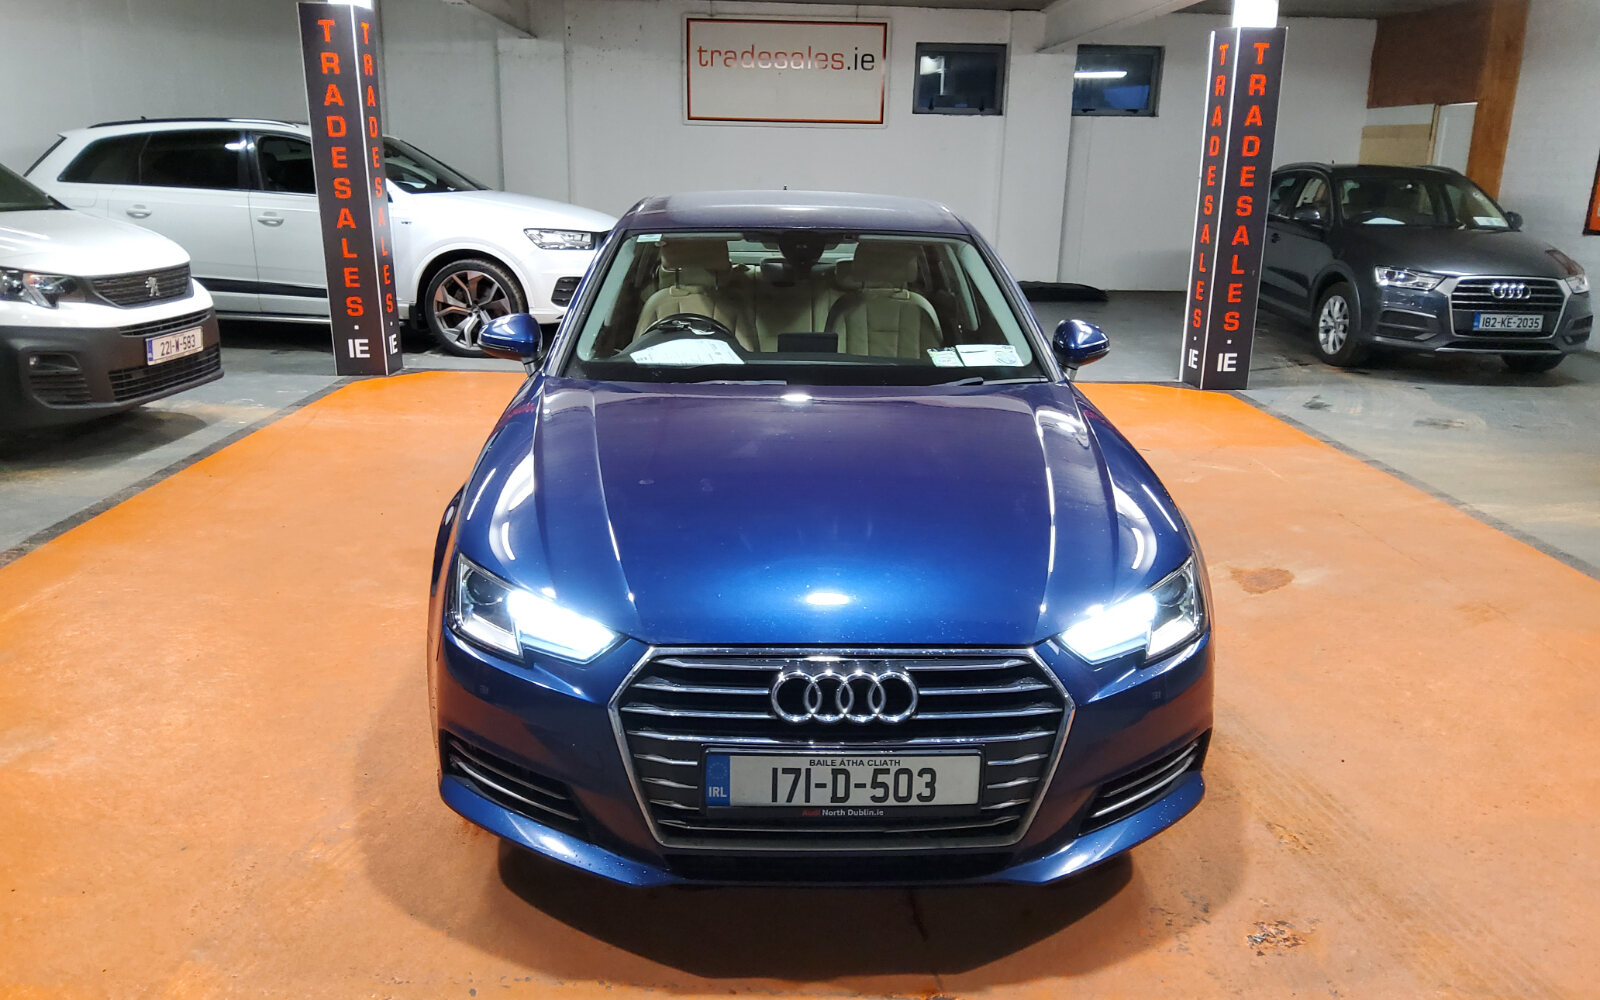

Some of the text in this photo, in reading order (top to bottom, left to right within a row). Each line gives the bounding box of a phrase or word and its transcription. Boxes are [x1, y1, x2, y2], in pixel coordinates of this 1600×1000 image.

[697, 44, 875, 71] tradesales.ie
[1481, 317, 1540, 329] 182-KE-2035
[809, 759, 837, 767] BAILE
[867, 759, 901, 767] CLIATH
[771, 767, 937, 804] 171-D-503
[708, 786, 728, 798] IRL
[802, 808, 884, 817] Audi North Dublin.ie
